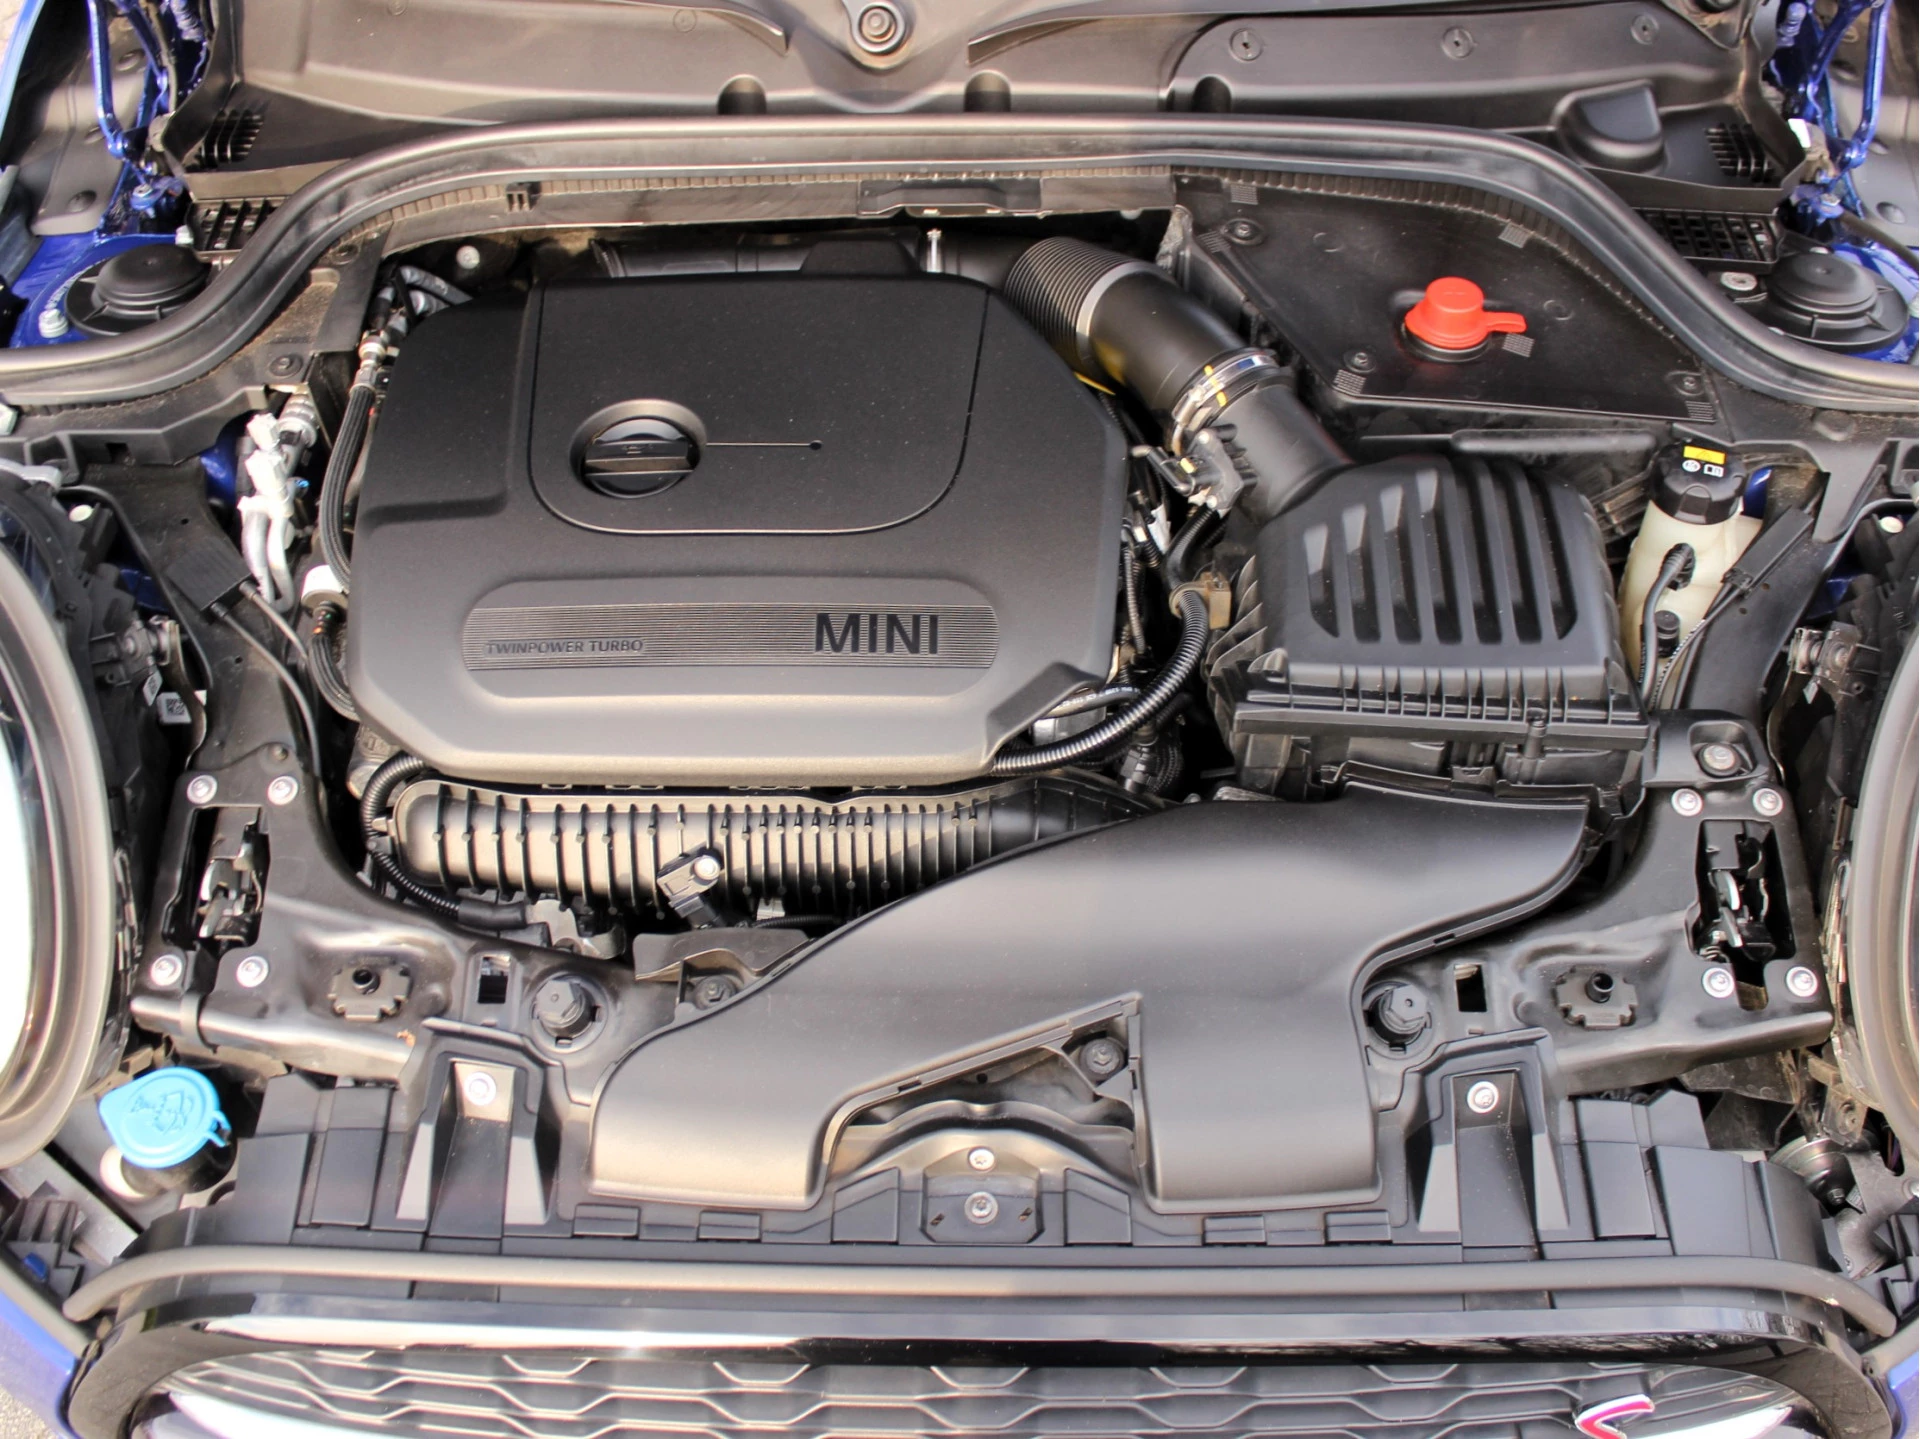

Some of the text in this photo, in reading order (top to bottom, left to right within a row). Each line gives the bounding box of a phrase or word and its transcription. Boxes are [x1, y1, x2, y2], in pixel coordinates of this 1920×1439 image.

[486, 639, 644, 654] TWINPOWER TURBO
[815, 612, 939, 654] MINI
